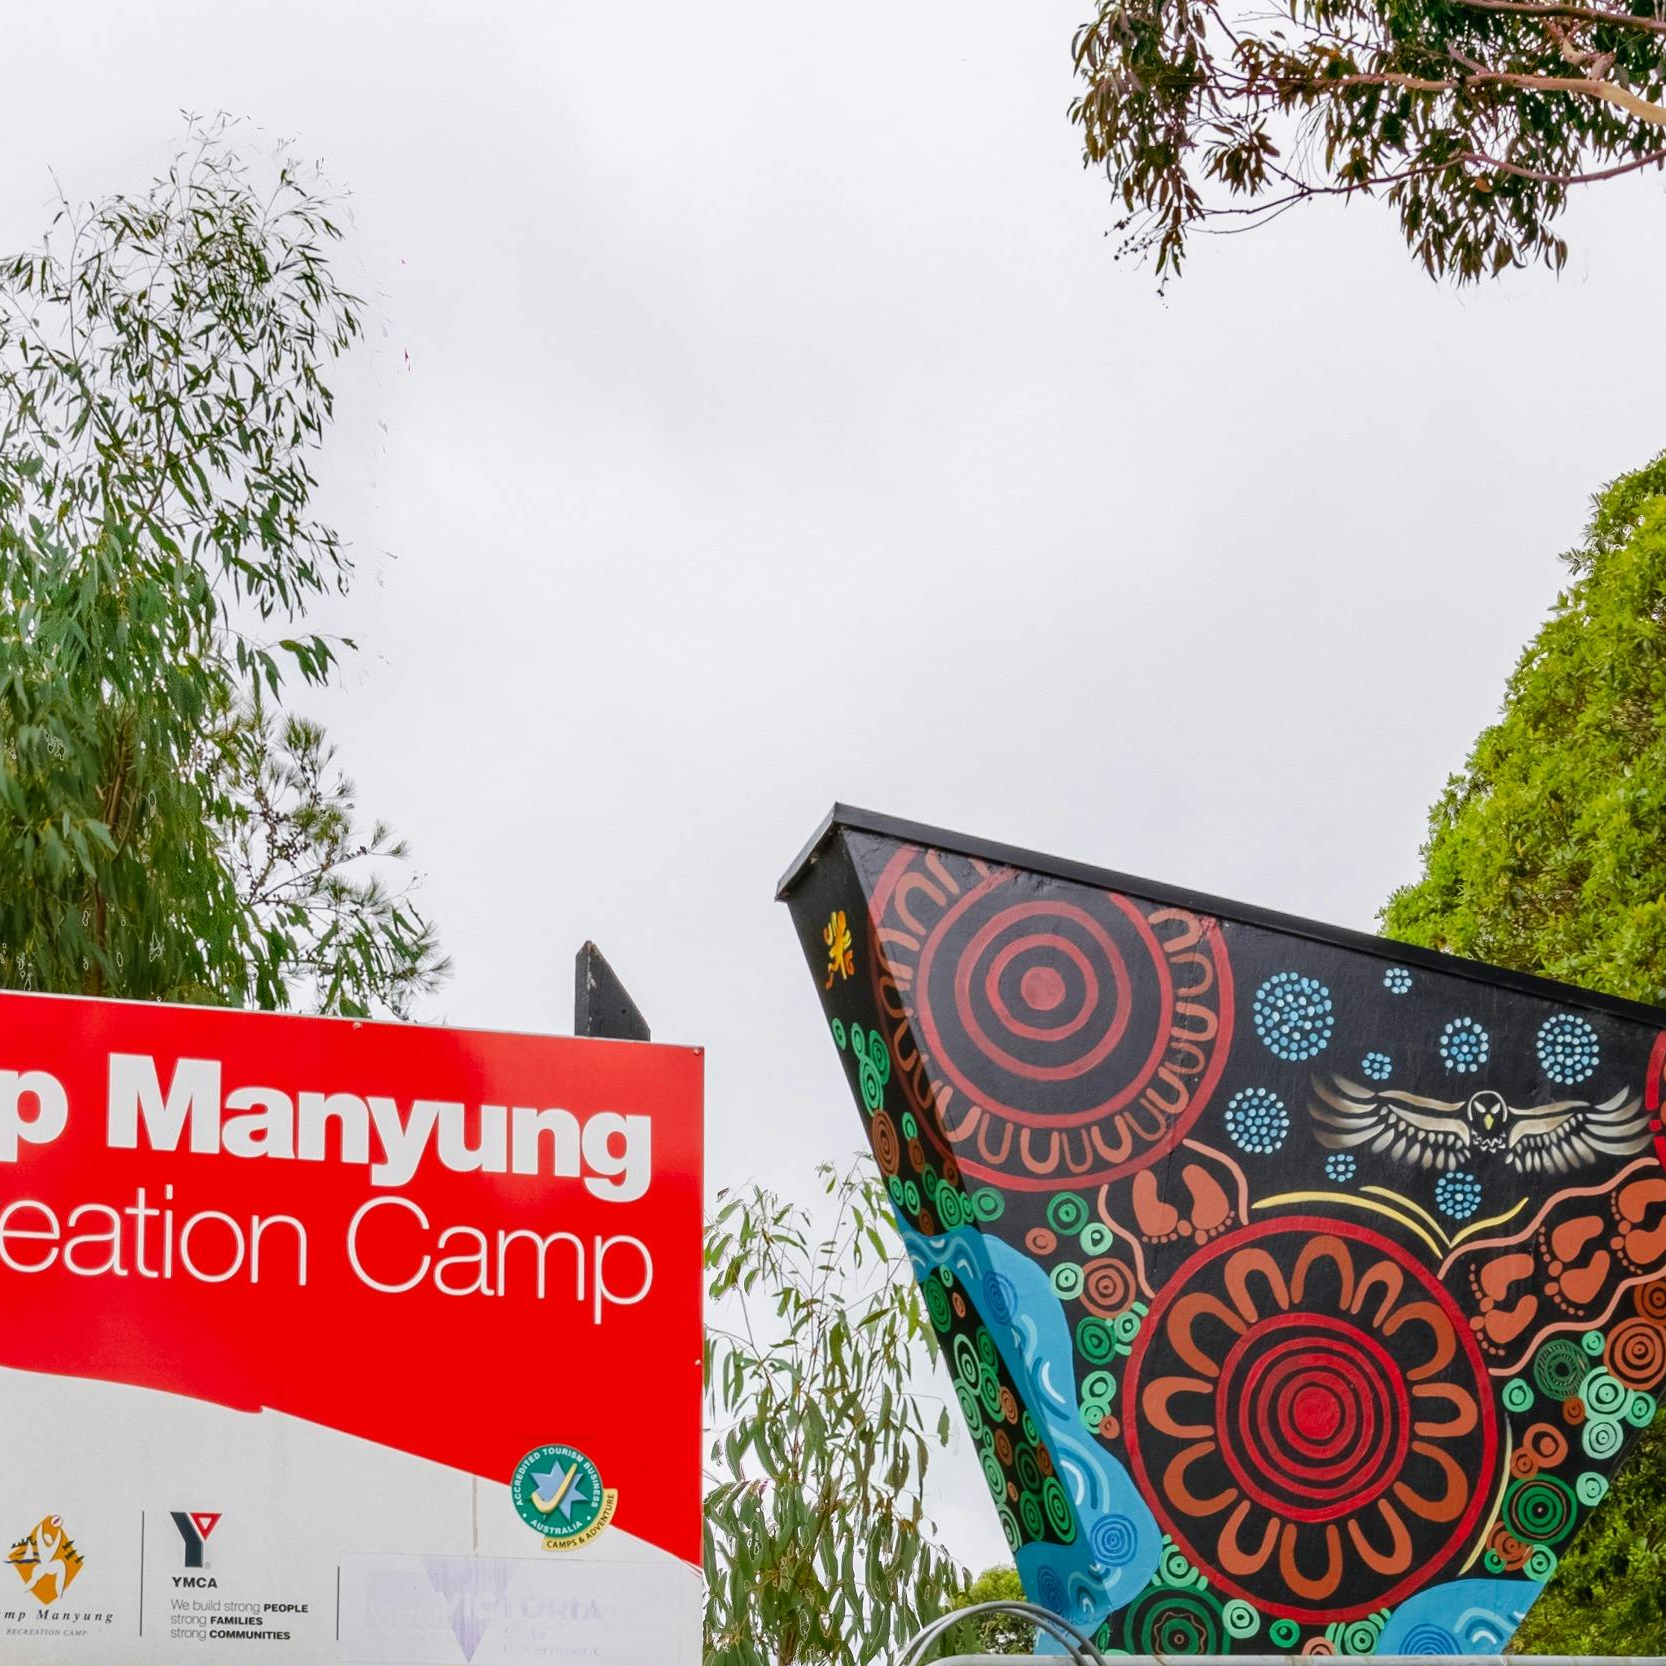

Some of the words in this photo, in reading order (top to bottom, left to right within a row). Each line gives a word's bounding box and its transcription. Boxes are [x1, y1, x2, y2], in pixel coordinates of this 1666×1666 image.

[107, 1052, 652, 1202] Manyung
[346, 1195, 653, 1325] Camp
[514, 1451, 541, 1506] ACCREDITED
[542, 1447, 584, 1463] TOURISM
[583, 1461, 601, 1508] BUSINESS
[530, 1519, 583, 1535] AUSTRALIA
[546, 1538, 577, 1549] CAMPS
[578, 1536, 585, 1544] &
[585, 1493, 615, 1541] ADVENTURE
[171, 1576, 218, 1589] YMCA
[170, 1599, 190, 1612] We
[193, 1600, 221, 1612] build
[224, 1601, 261, 1615] strong
[263, 1603, 309, 1613] PEOPLE
[36, 1609, 114, 1624] Manyung
[170, 1614, 207, 1627] strong
[210, 1616, 264, 1626] FAMILIES
[6, 1627, 61, 1637] RECREATION
[63, 1629, 88, 1637] CAMP
[170, 1628, 207, 1641] strong
[209, 1630, 291, 1640] COMMUNITIES
